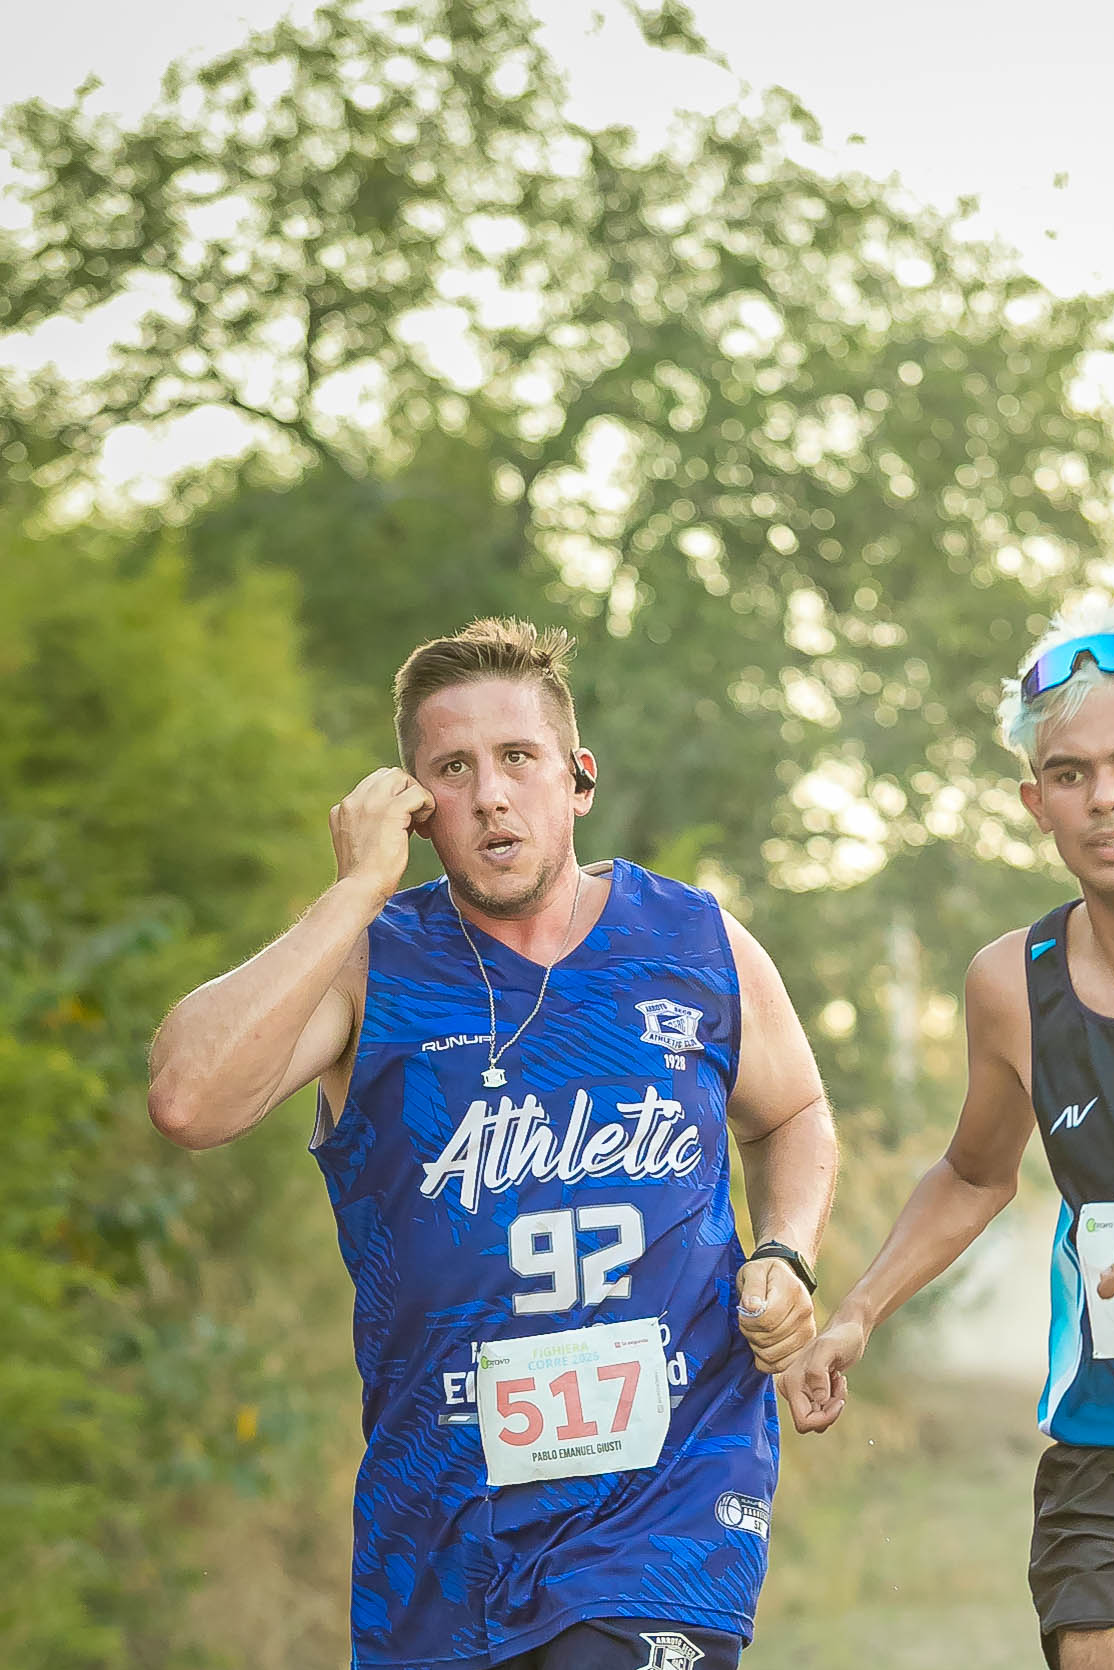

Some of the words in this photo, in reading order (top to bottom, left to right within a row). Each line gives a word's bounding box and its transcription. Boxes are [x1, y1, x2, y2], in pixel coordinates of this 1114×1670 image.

[664, 1053, 686, 1071] 1928
[419, 1085, 702, 1214] Athletic
[508, 1203, 645, 1315] 92
[496, 1360, 641, 1447] 517
[531, 1449, 558, 1463] PABLO
[559, 1444, 596, 1459] EMANUEL
[597, 1440, 622, 1454] GIUSTI
